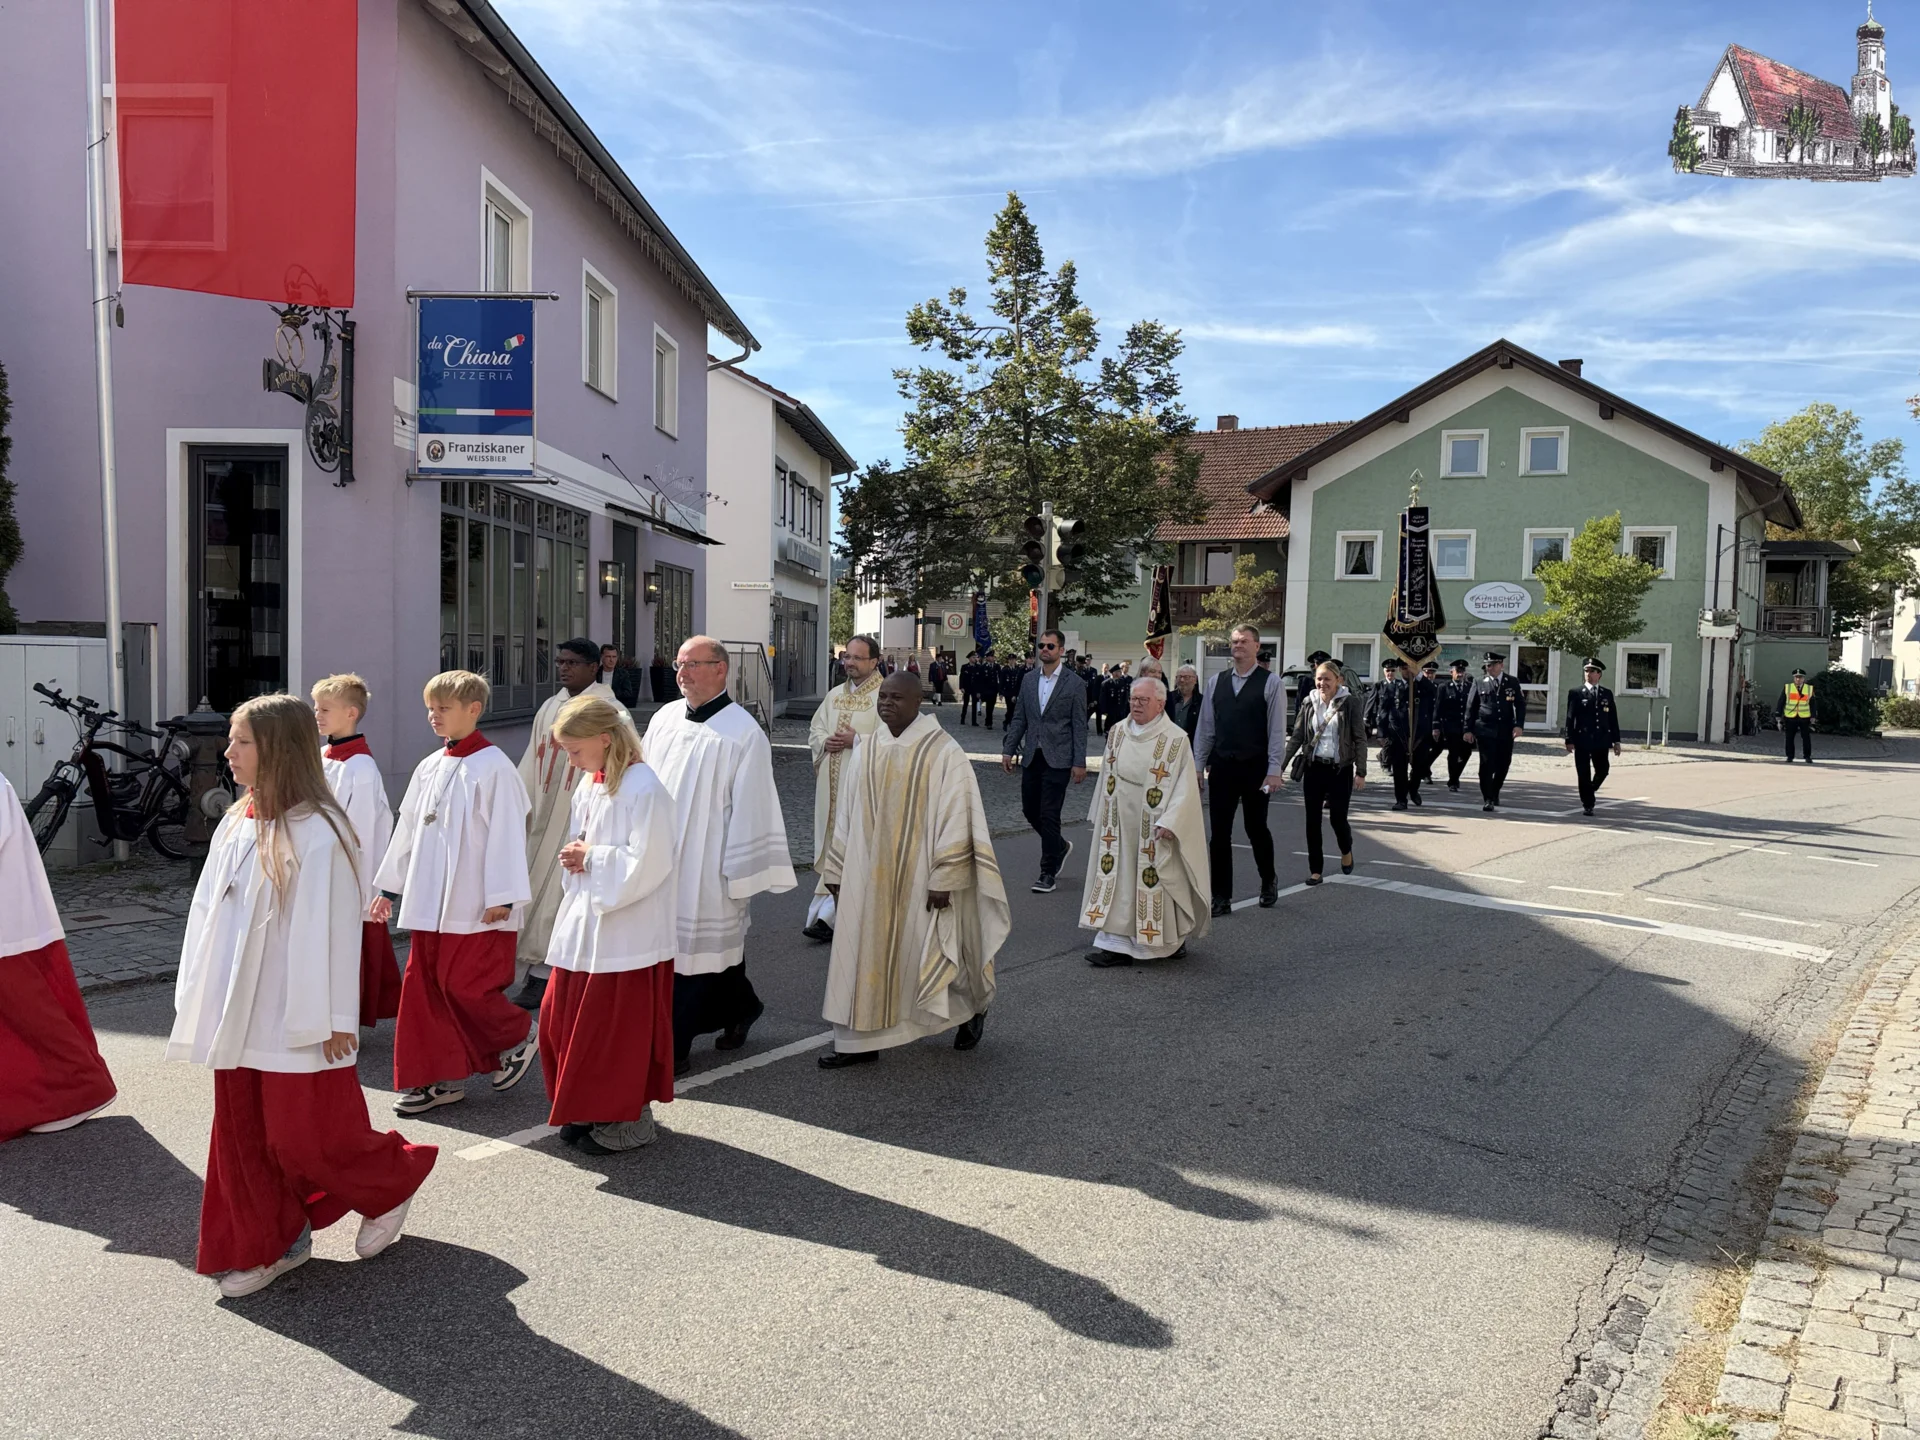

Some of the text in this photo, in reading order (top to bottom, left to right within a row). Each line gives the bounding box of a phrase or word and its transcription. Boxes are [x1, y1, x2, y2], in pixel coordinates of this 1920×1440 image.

[428, 334, 513, 367] da Chiara
[443, 371, 513, 381] PIZZERIA
[448, 442, 525, 454] Franziskaner
[466, 455, 507, 463] WEISSBIER
